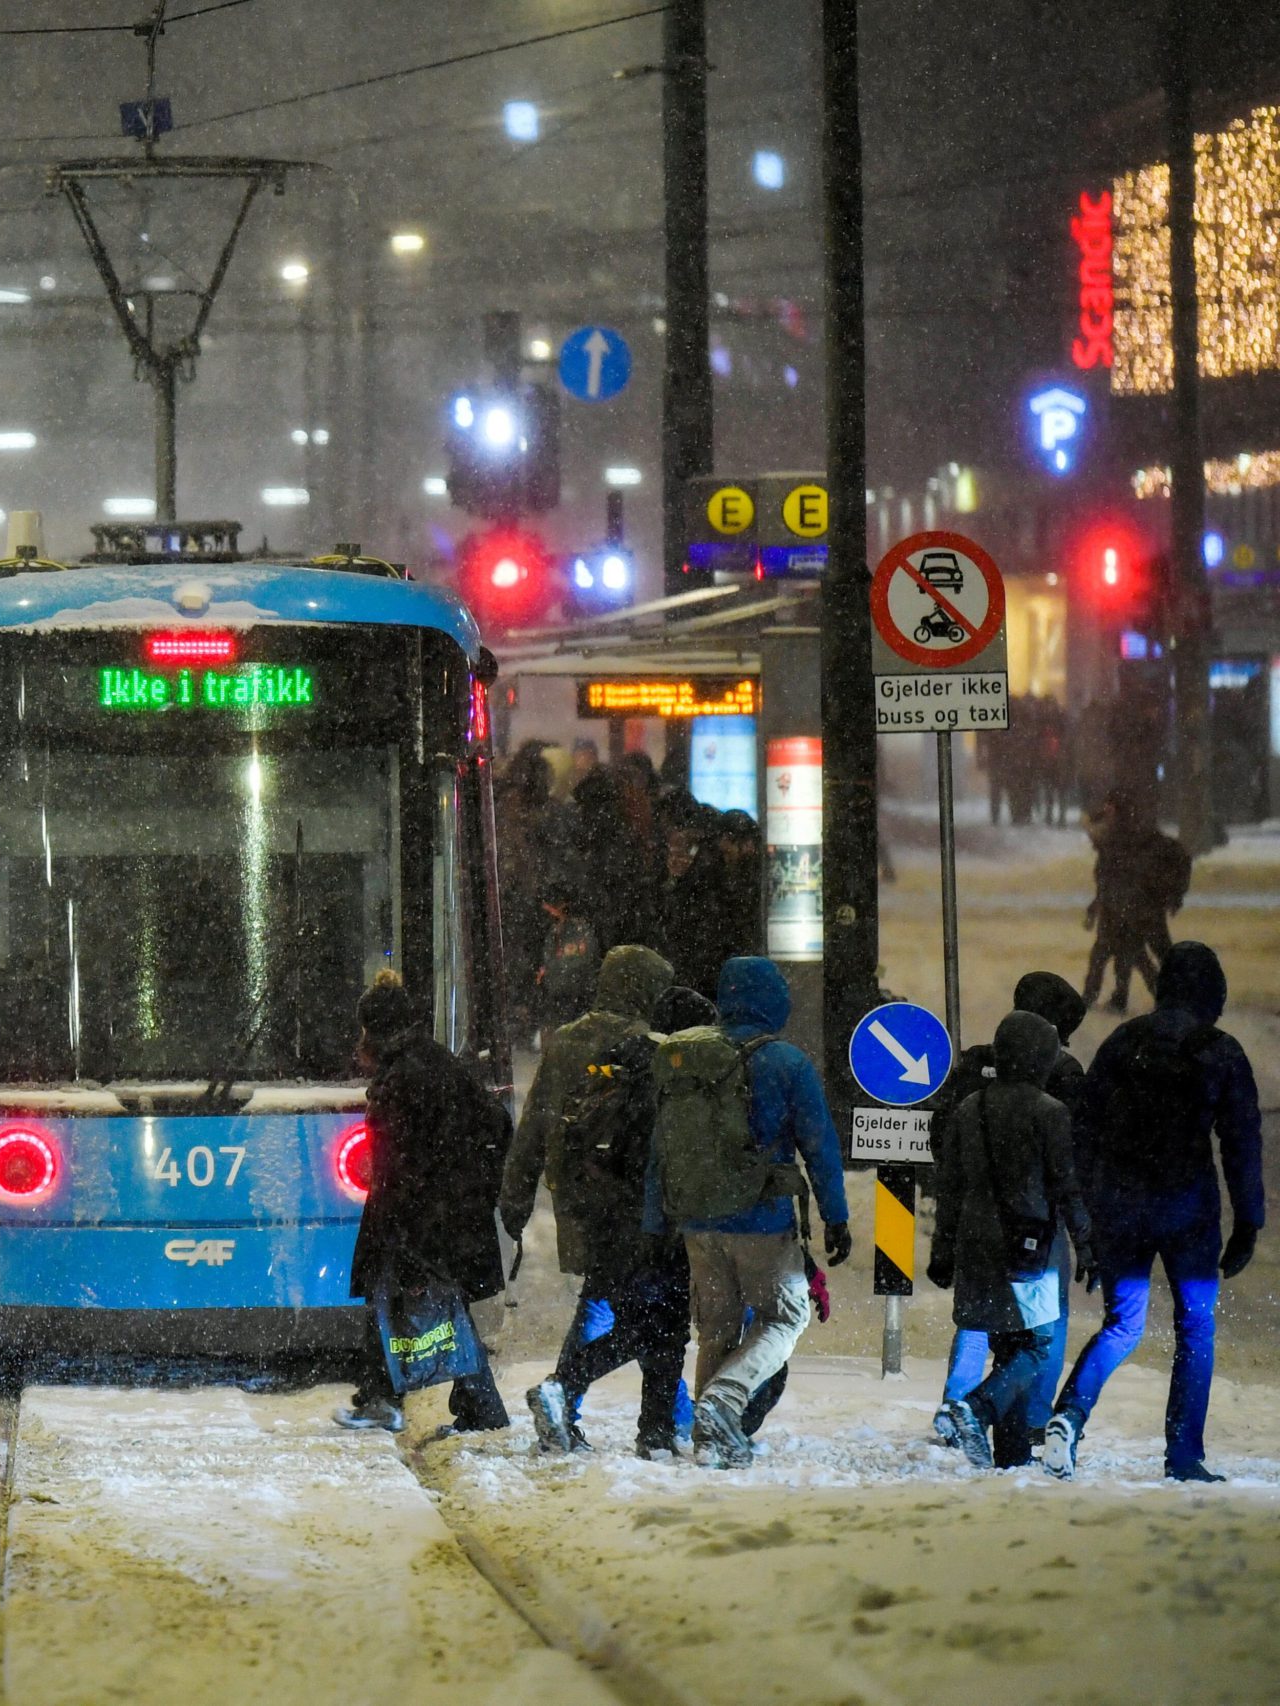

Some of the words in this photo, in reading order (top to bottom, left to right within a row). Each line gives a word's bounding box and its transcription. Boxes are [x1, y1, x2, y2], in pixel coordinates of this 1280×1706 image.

[1071, 190, 1113, 369] Scandic
[1041, 407, 1077, 451] P
[721, 496, 741, 526] E
[799, 494, 821, 528] E
[102, 669, 167, 705] Ikke
[181, 669, 191, 703] i
[205, 667, 312, 704] trafikk
[880, 679, 953, 702] Gjelder
[961, 677, 1002, 695] ikke
[877, 707, 925, 725] buss
[934, 708, 959, 727] og
[969, 703, 1007, 722] taxi
[854, 1115, 908, 1132] Gjelder
[913, 1118, 931, 1132] ik
[856, 1134, 891, 1150] buss
[898, 1137, 902, 1150] i
[909, 1138, 931, 1152] rut
[154, 1145, 246, 1187] 407
[164, 1239, 236, 1267] CAF
